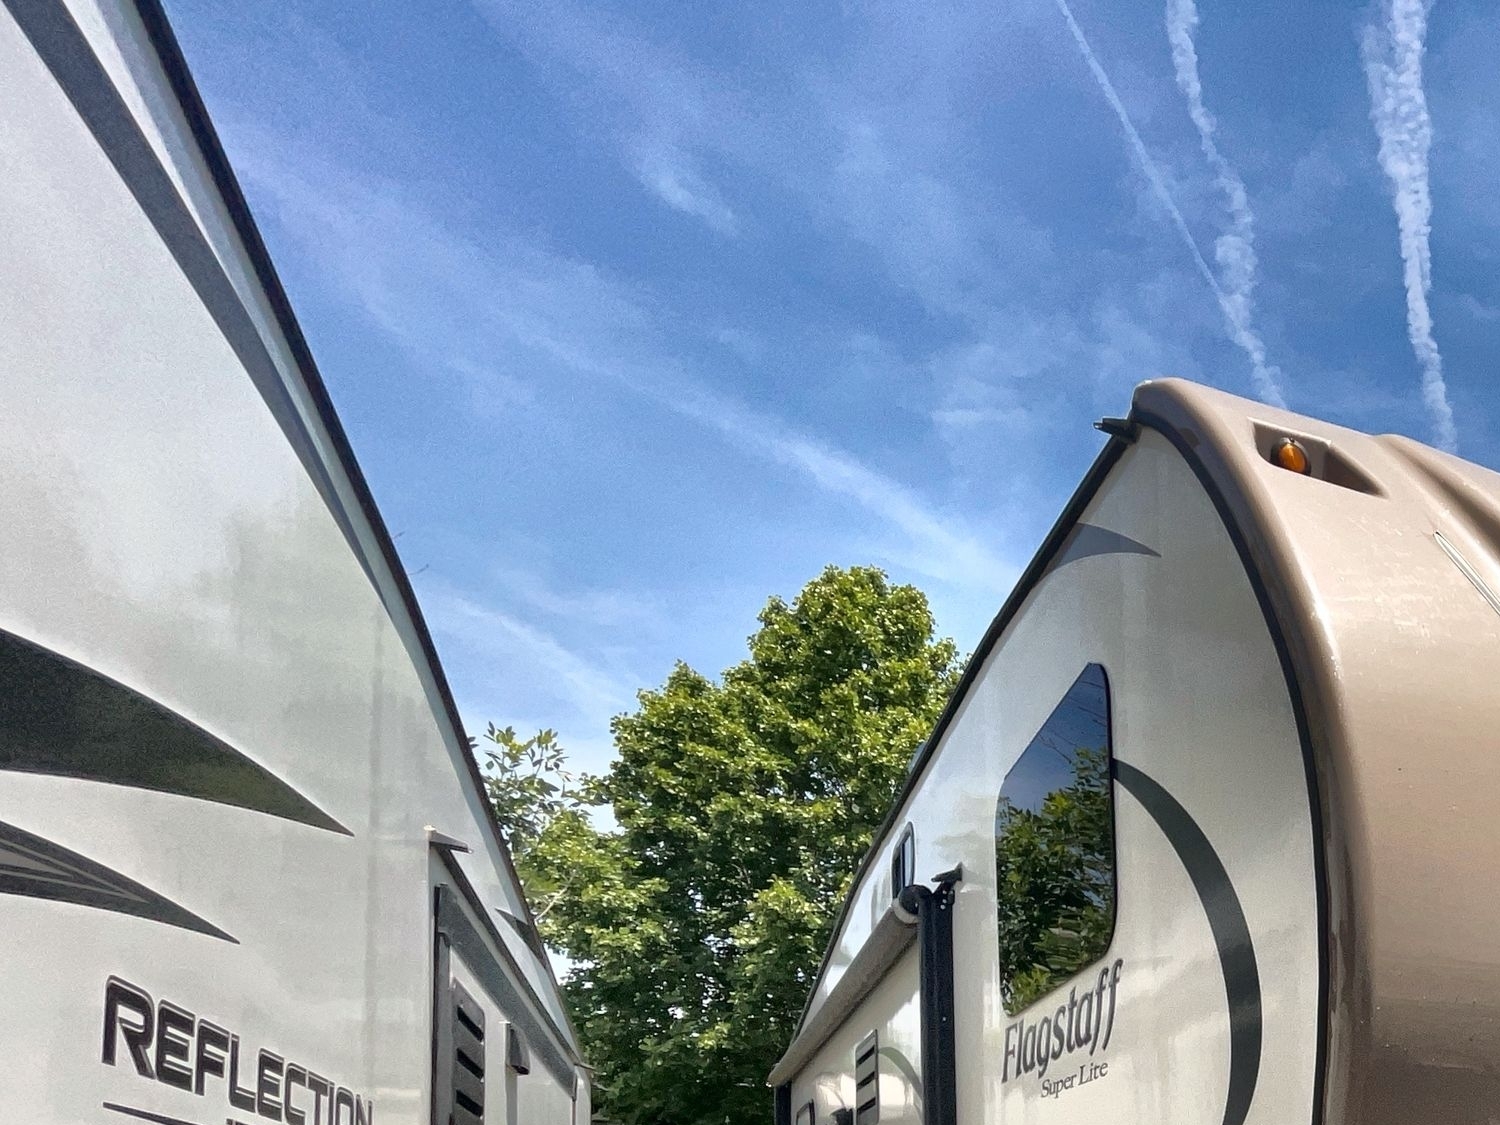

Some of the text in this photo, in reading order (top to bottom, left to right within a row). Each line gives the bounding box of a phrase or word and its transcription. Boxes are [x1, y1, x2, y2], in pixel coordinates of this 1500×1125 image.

[1001, 958, 1124, 1084] Flagstaff
[1040, 1062, 1109, 1099] Super Lite
